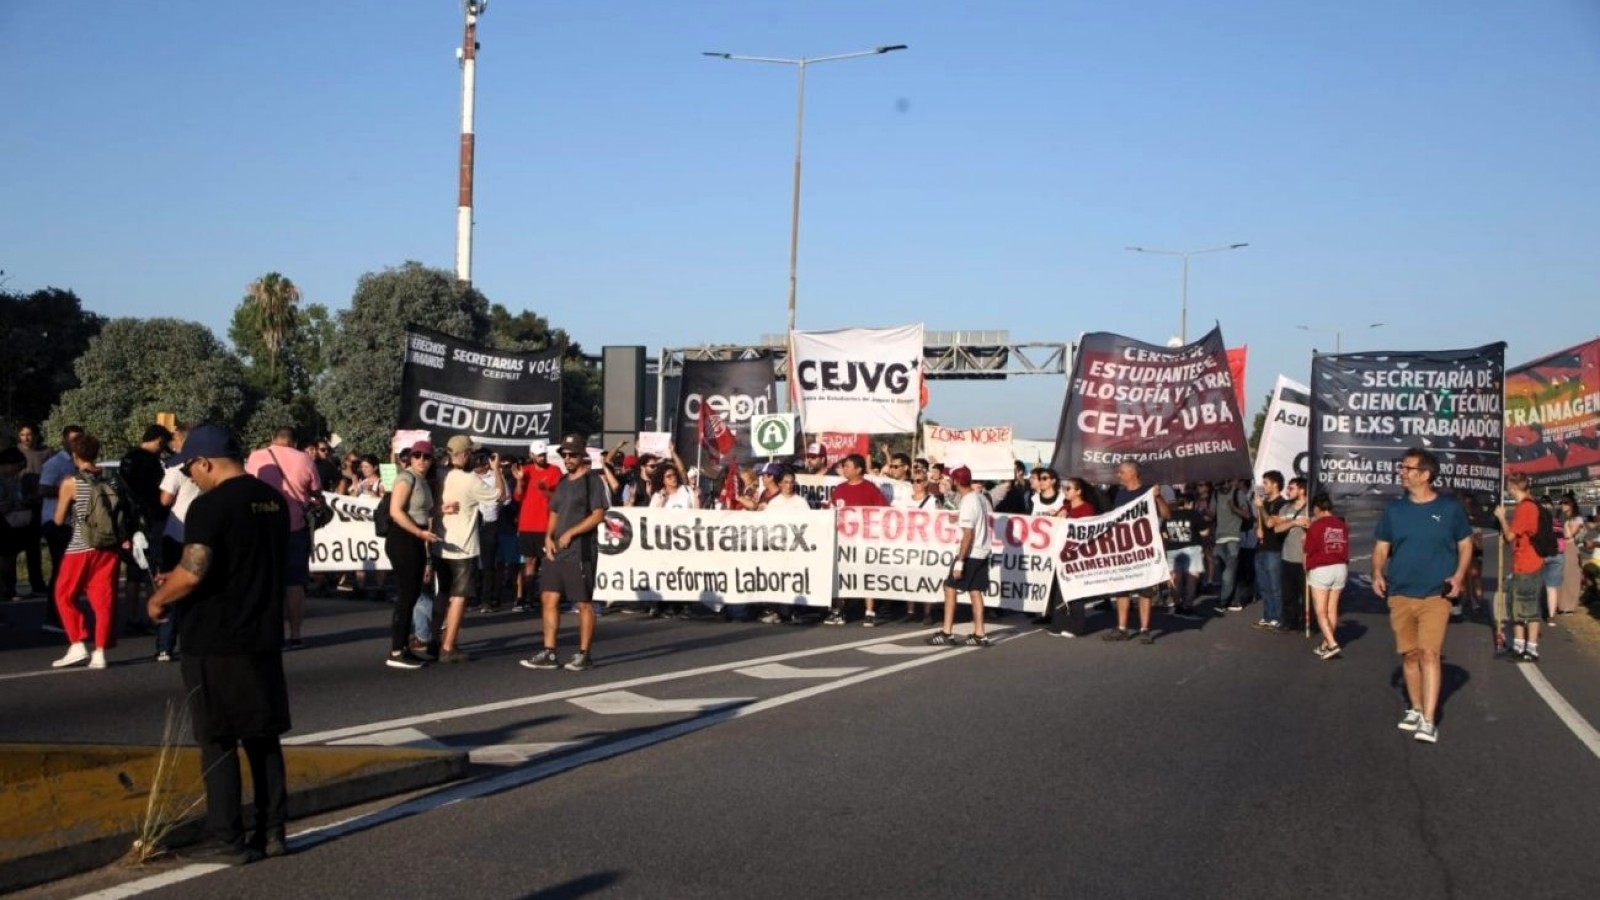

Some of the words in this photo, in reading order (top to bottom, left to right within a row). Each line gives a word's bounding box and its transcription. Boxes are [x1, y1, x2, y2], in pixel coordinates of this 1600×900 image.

[453, 349, 525, 371] SECRETARIAS
[798, 359, 909, 394] CEJVG
[1362, 365, 1473, 388] SECRETARÍA
[1477, 369, 1493, 388] DE
[1175, 387, 1185, 403] Y
[1348, 392, 1427, 411] CIENCIA
[1430, 393, 1443, 411] Y
[1449, 389, 1501, 414] TÉCNICA
[419, 400, 552, 435] CEDUNPAZ
[1077, 410, 1168, 437] CEFYL
[1181, 401, 1234, 431] UBA
[1274, 409, 1309, 428] Asu
[1322, 415, 1350, 432] DE
[1354, 416, 1394, 434] LXS
[970, 427, 1009, 444] NORTE
[1175, 440, 1236, 457] GENERAL
[1320, 457, 1372, 470] VOCALÍA
[1376, 461, 1392, 471] EN
[1456, 464, 1468, 475] DE
[1319, 472, 1333, 483] DE
[1337, 472, 1392, 484] CIENCIAS
[1445, 477, 1452, 487] Y
[837, 506, 1053, 550] GEORGLOS
[332, 541, 344, 562] a
[347, 537, 380, 562] los
[1060, 517, 1153, 563] BORDO
[838, 545, 857, 563] NI
[866, 547, 957, 567] DESPIDO
[594, 571, 608, 591] o
[612, 571, 624, 591] a
[630, 567, 650, 592] la
[656, 565, 728, 593] reforma
[839, 574, 857, 591] NI
[864, 574, 965, 595] ESCLAV
[984, 580, 1047, 601] DENTRO
